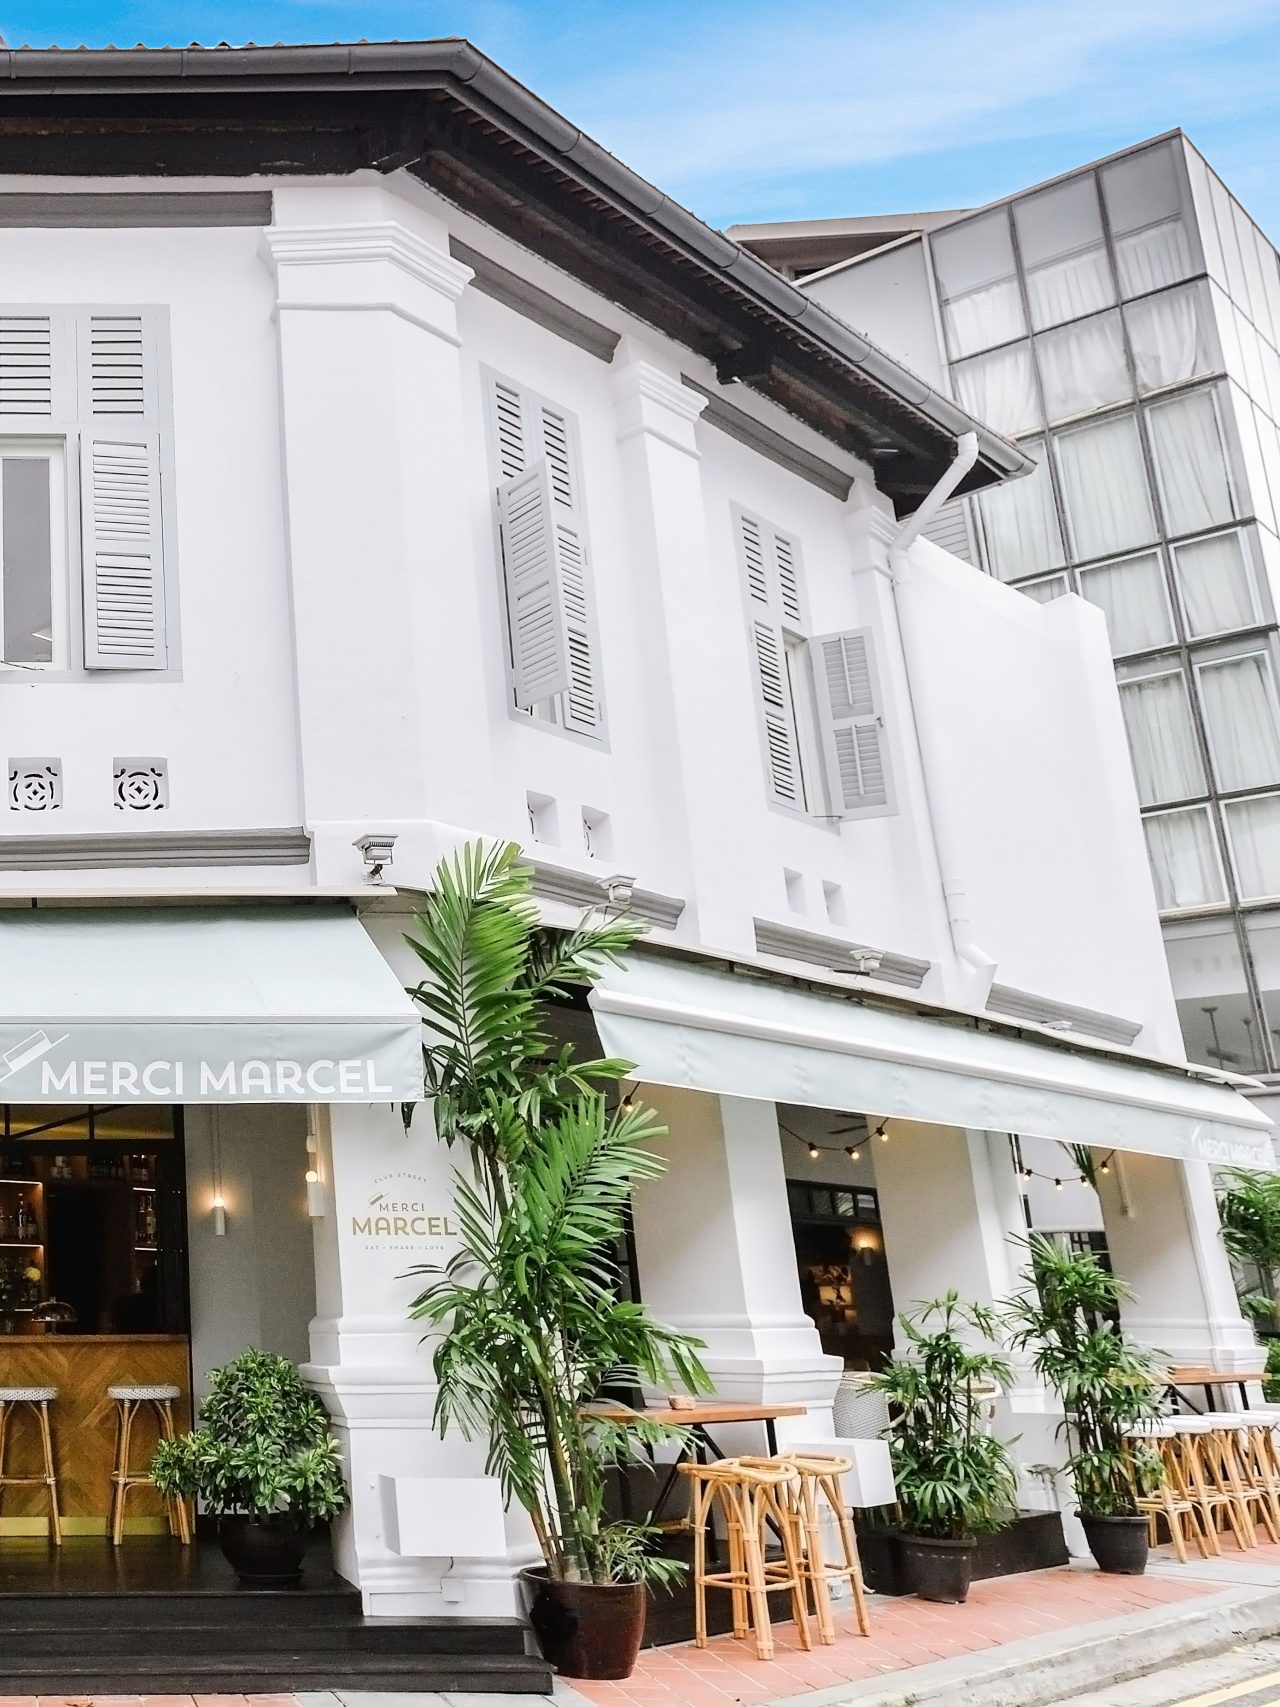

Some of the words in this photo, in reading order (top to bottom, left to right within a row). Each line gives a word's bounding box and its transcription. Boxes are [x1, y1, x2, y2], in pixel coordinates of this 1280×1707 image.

[41, 1061, 183, 1095] MERCI
[200, 1059, 393, 1095] MARCEL
[374, 1174, 393, 1184] CLUB
[397, 1173, 428, 1183] STREET
[379, 1203, 425, 1212] MERCI
[352, 1217, 457, 1235] MARCEL
